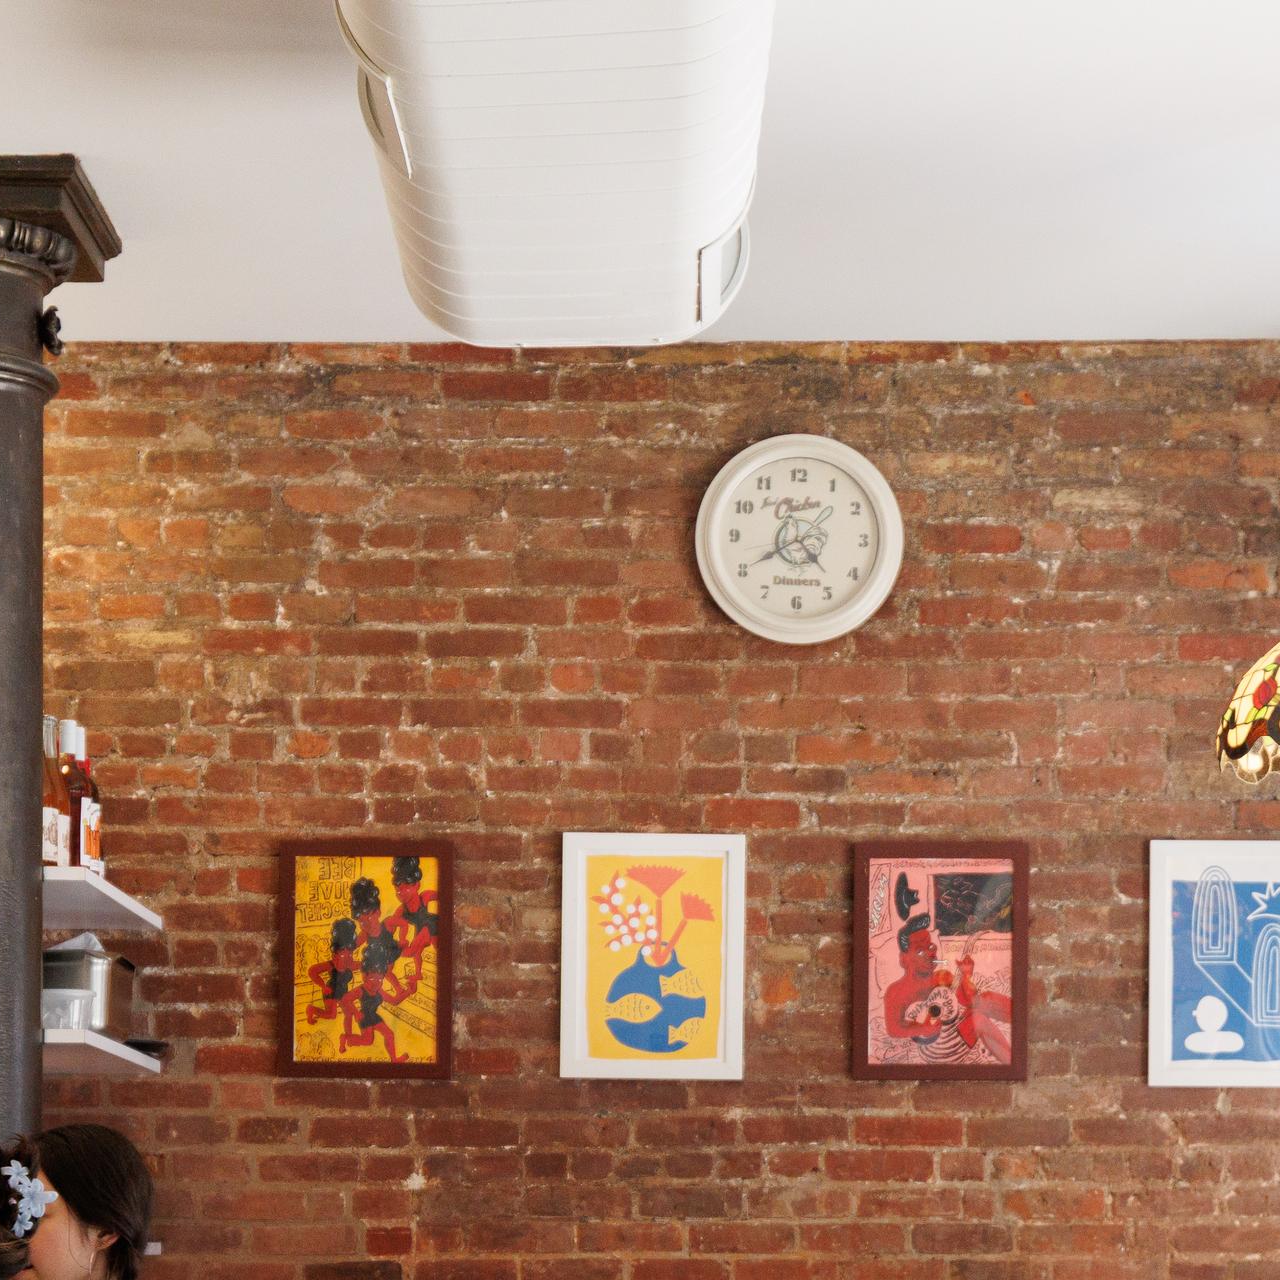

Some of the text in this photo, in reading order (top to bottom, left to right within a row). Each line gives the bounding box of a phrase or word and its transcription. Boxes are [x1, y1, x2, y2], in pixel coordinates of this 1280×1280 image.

[790, 468, 808, 483] 12
[756, 476, 771, 490] 11
[829, 478, 836, 493] 1
[735, 500, 754, 514] 10
[850, 501, 861, 515] 2
[729, 529, 741, 542] 9
[858, 533, 869, 548] 3
[738, 563, 748, 577] 8
[847, 567, 859, 580] 4
[773, 575, 821, 587] Dinners
[760, 585, 769, 599] 7
[822, 586, 832, 600] 5
[791, 596, 802, 610] 6
